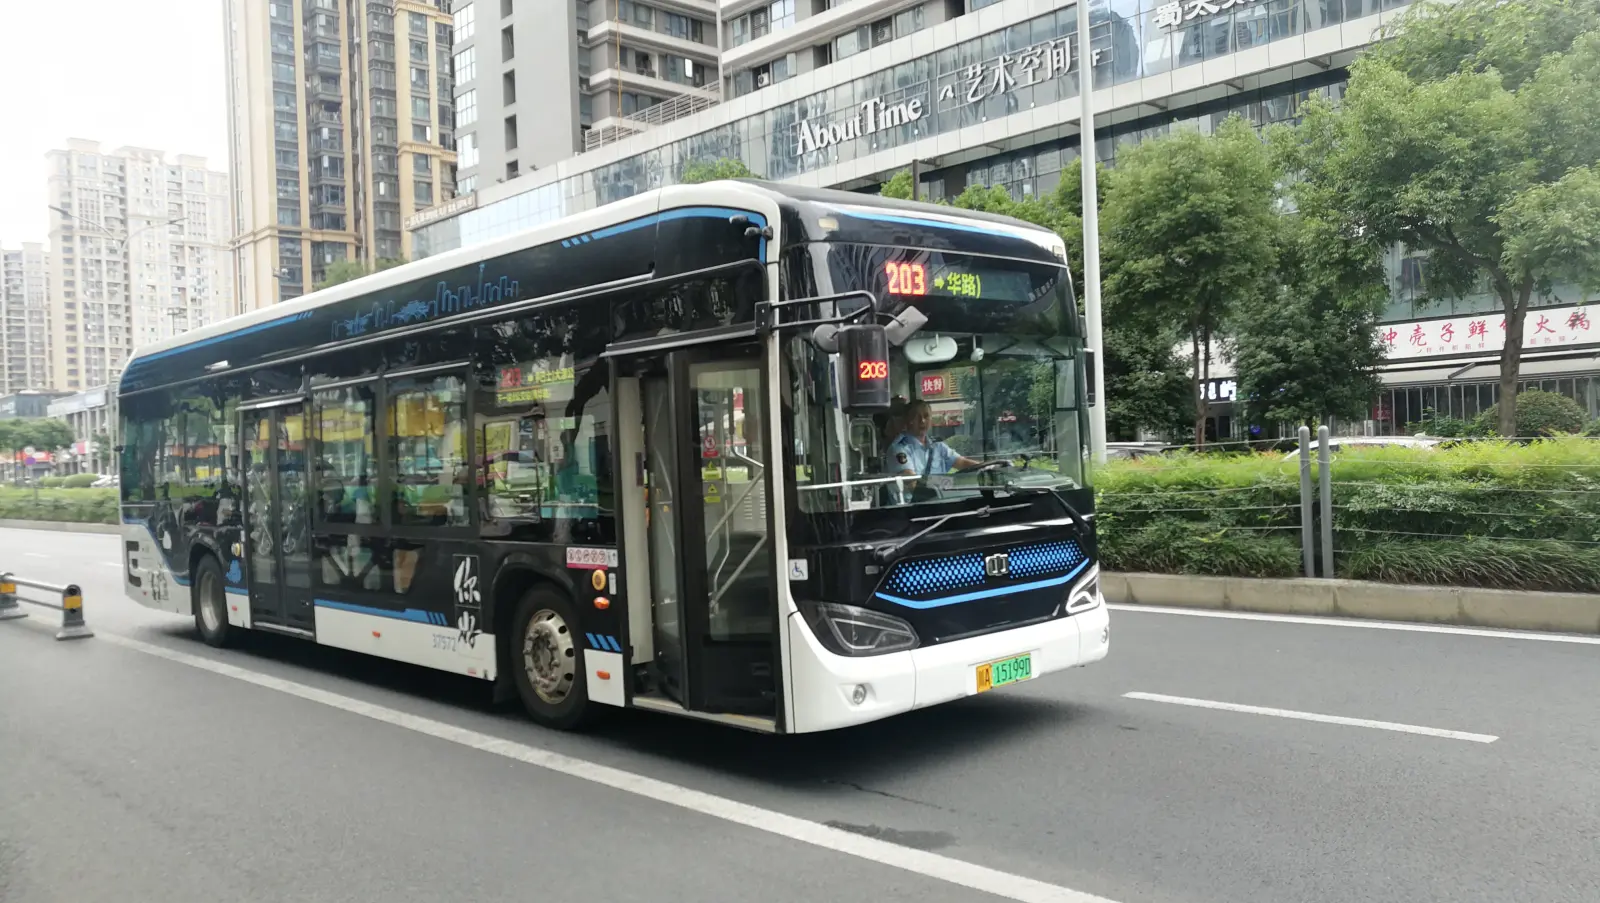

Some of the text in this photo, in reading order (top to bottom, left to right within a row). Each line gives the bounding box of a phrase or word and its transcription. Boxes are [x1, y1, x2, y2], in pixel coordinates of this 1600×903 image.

[964, 36, 1072, 102] 艺术空间
[797, 97, 923, 155] About Time
[886, 262, 927, 295] 203
[1380, 311, 1591, 348] 冲壳子鲜火锅
[860, 361, 888, 380] 203
